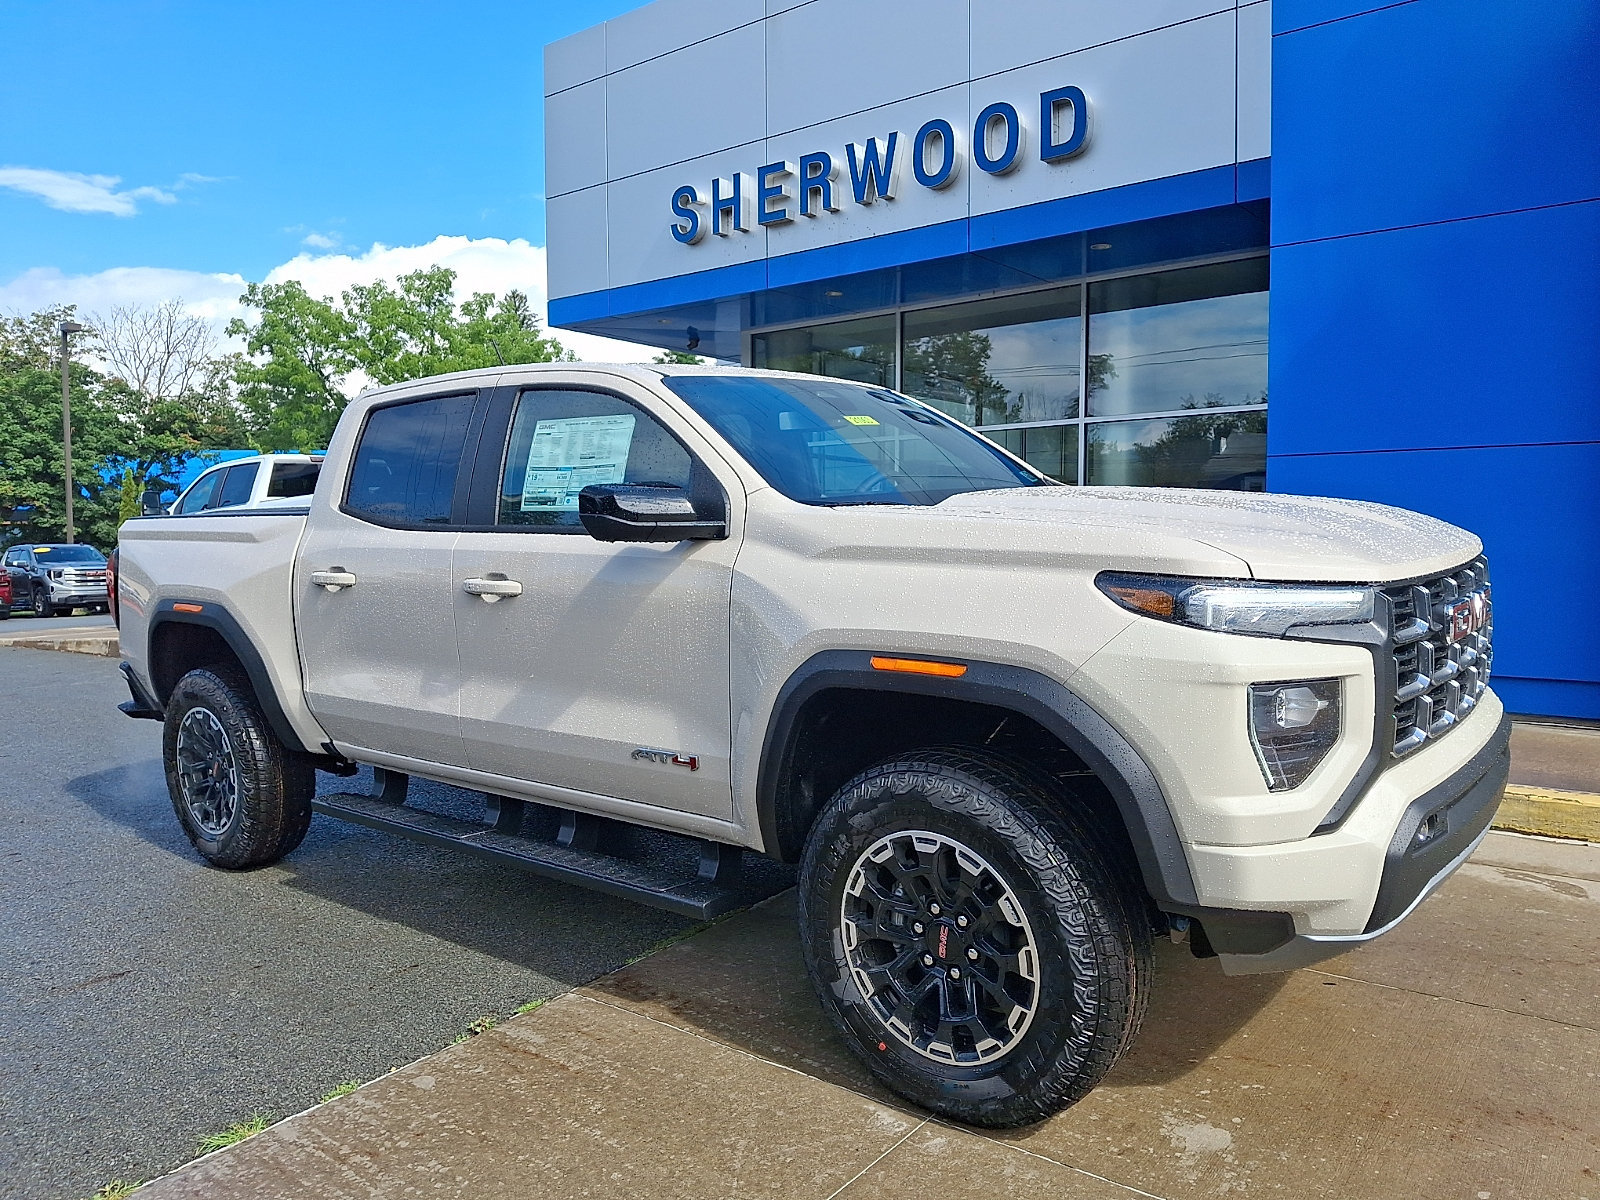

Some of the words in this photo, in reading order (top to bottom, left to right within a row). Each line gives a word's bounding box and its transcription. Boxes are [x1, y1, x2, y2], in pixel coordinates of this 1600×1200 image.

[670, 85, 1090, 245] SHERWOOD
[631, 747, 700, 772] AT4
[939, 925, 949, 959] GMC
